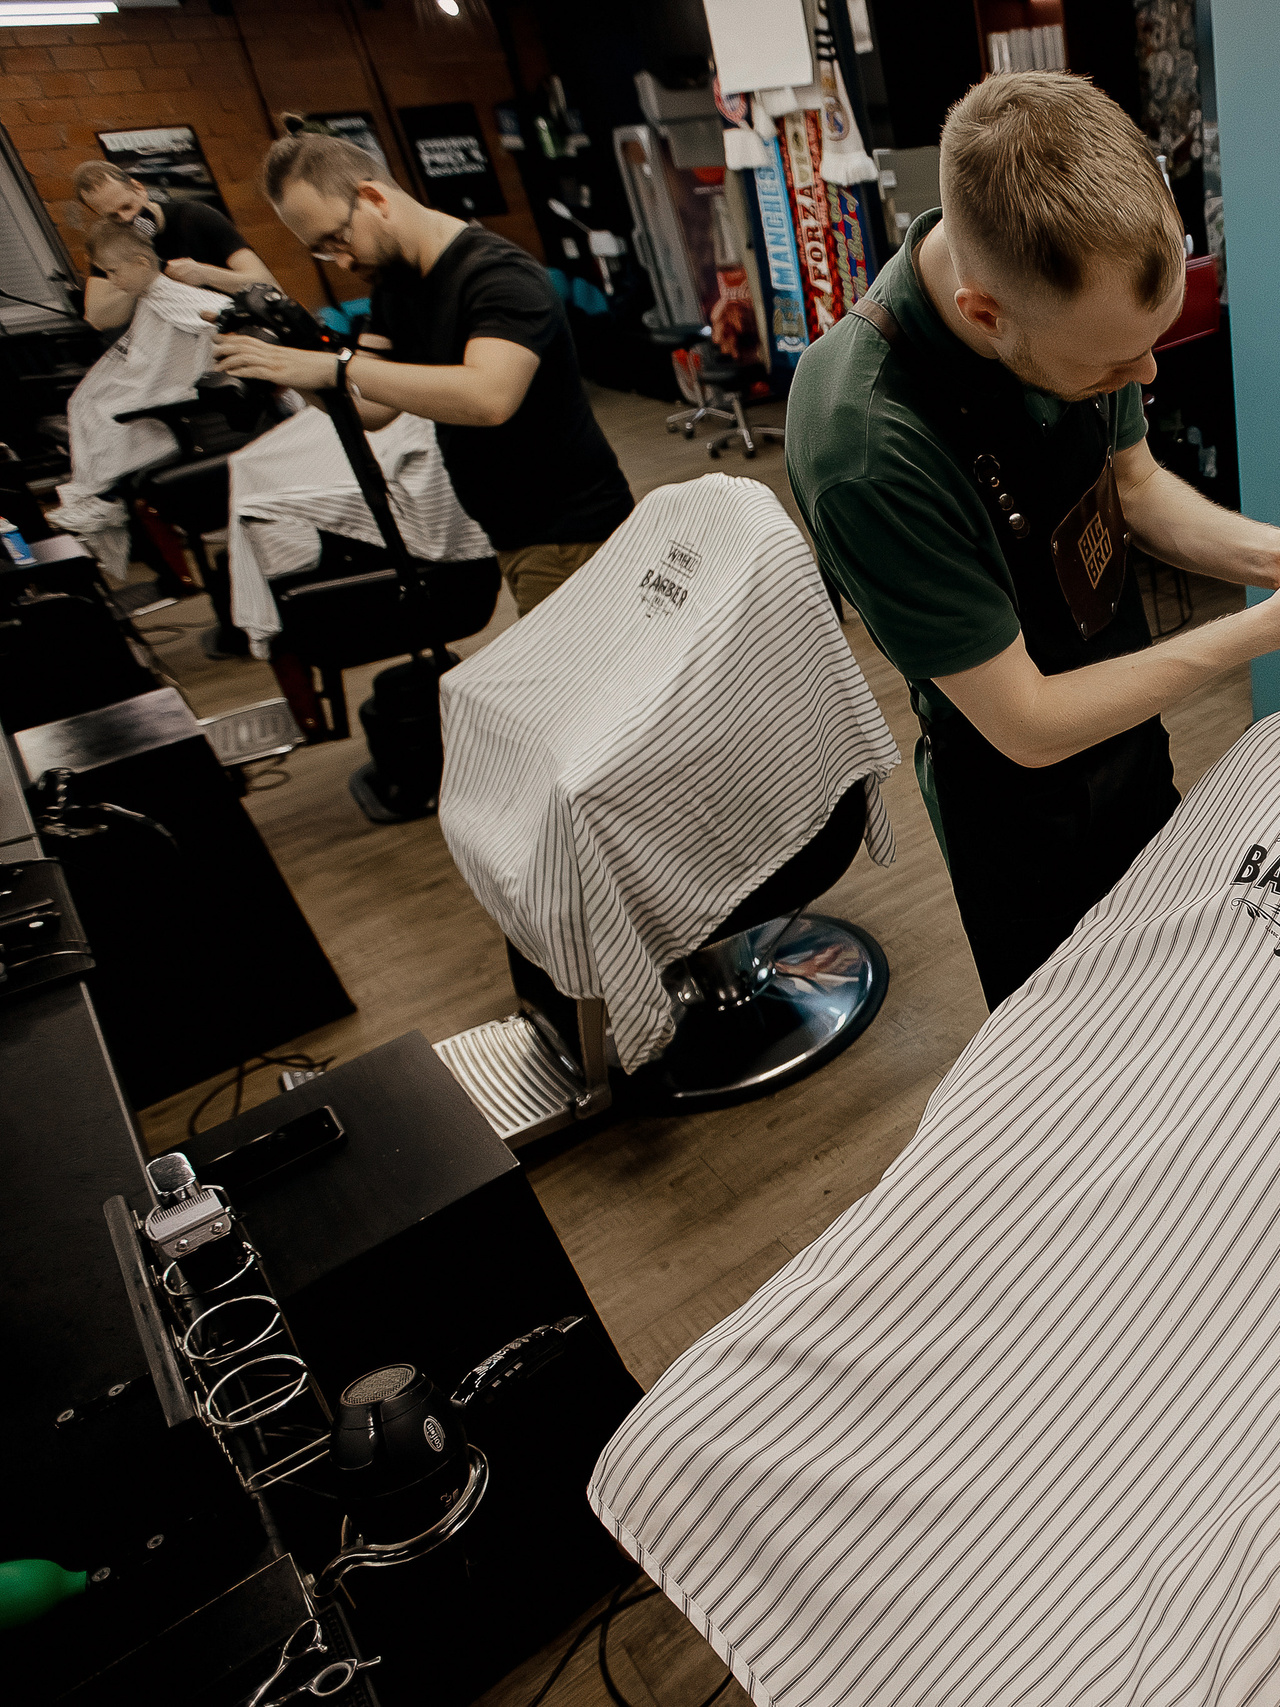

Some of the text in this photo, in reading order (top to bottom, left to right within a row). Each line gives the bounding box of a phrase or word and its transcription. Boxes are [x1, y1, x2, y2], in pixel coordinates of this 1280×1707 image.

[799, 186, 827, 282] FORZA
[667, 544, 699, 573] WAHL
[1078, 511, 1104, 565] BIG
[1086, 527, 1113, 589] BRO
[641, 570, 688, 609] BARBER
